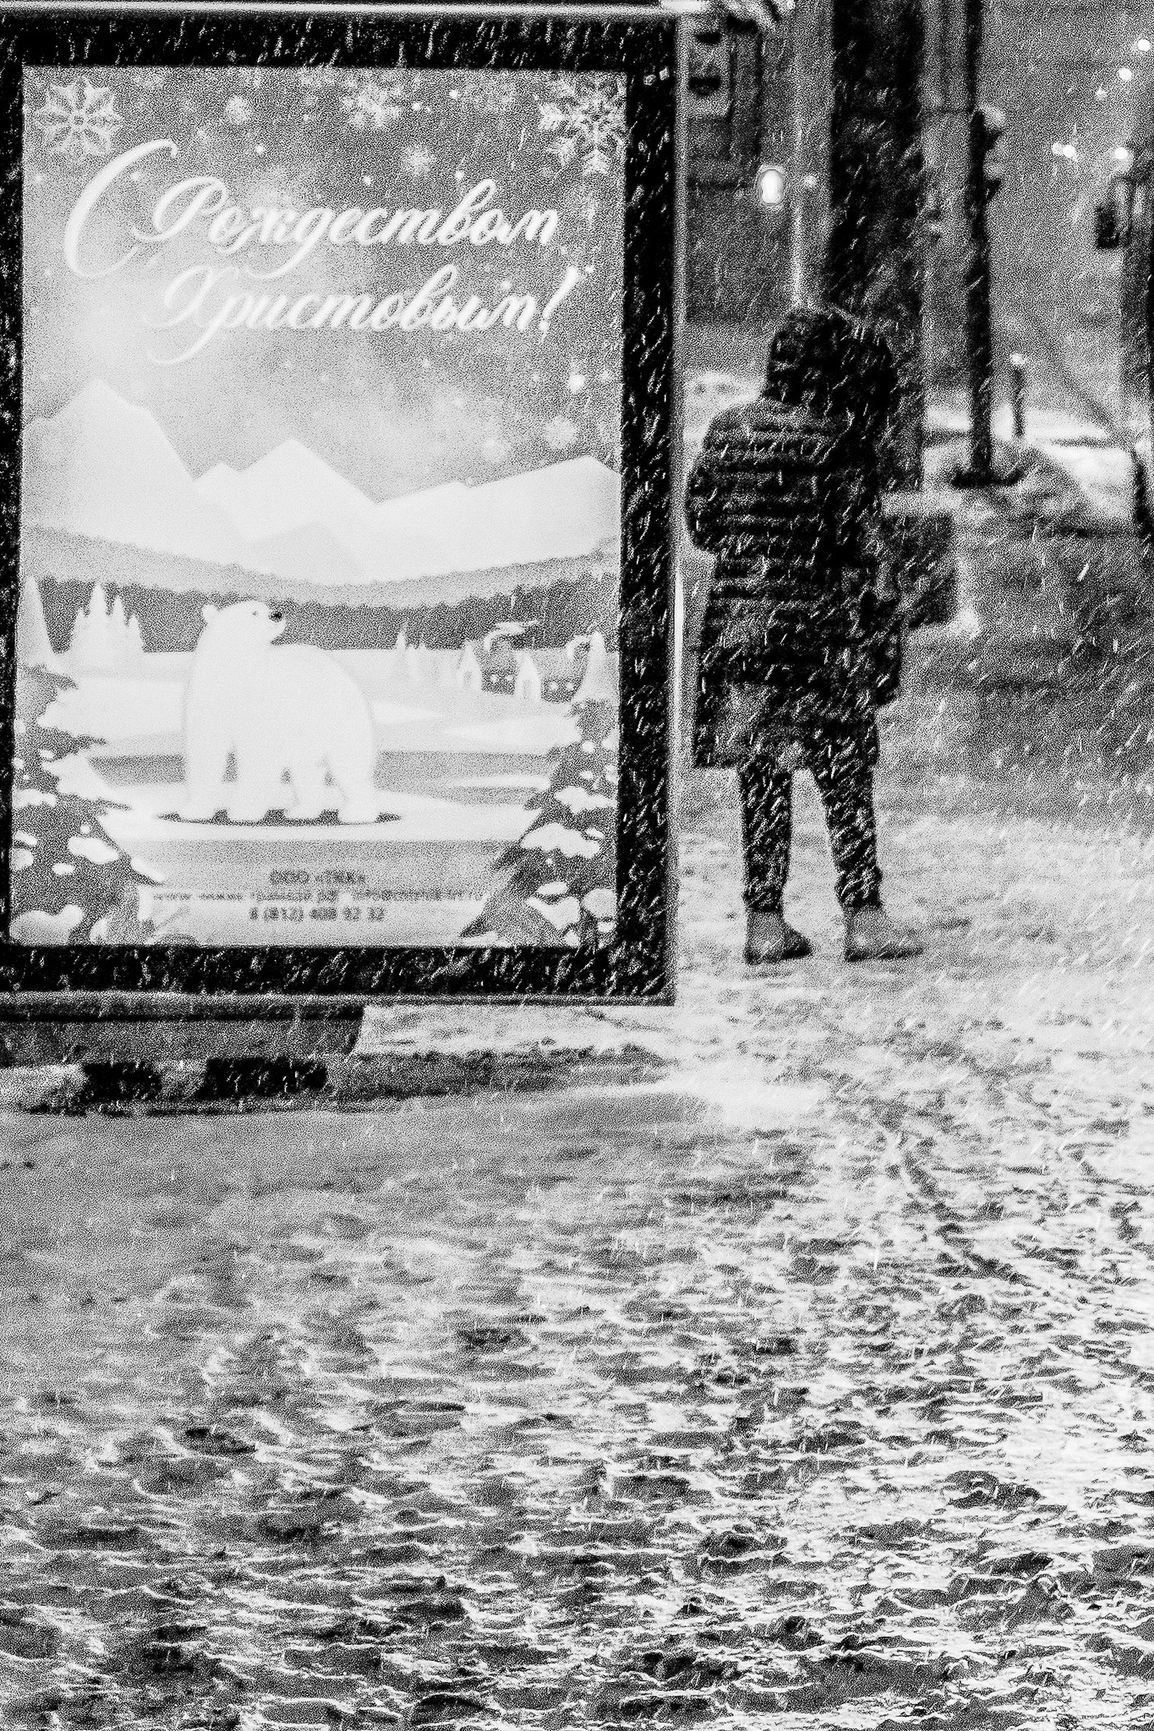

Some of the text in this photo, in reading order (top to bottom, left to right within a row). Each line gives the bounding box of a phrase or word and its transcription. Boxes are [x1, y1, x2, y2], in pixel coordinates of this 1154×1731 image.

[63, 138, 561, 281] С Рождеством
[144, 264, 583, 365] Христовым!
